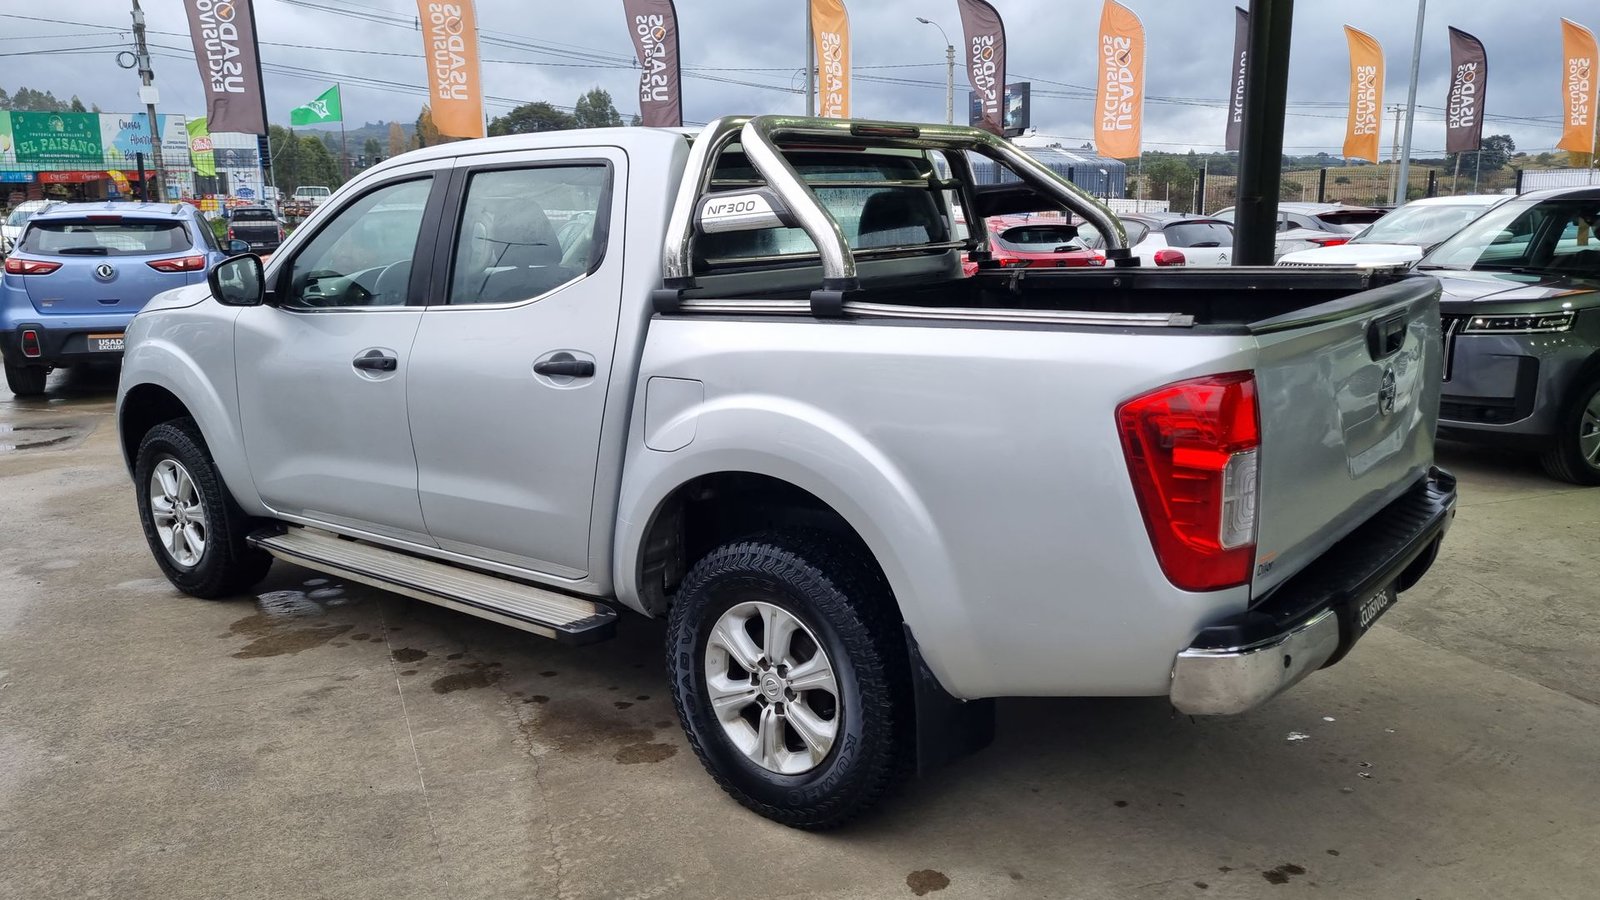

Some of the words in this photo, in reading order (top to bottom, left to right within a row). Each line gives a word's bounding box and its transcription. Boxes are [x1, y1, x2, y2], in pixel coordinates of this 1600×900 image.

[20, 141, 38, 154] EL
[40, 138, 96, 154] PAISANO
[707, 201, 755, 215] NP300
[98, 338, 124, 346] USAD
